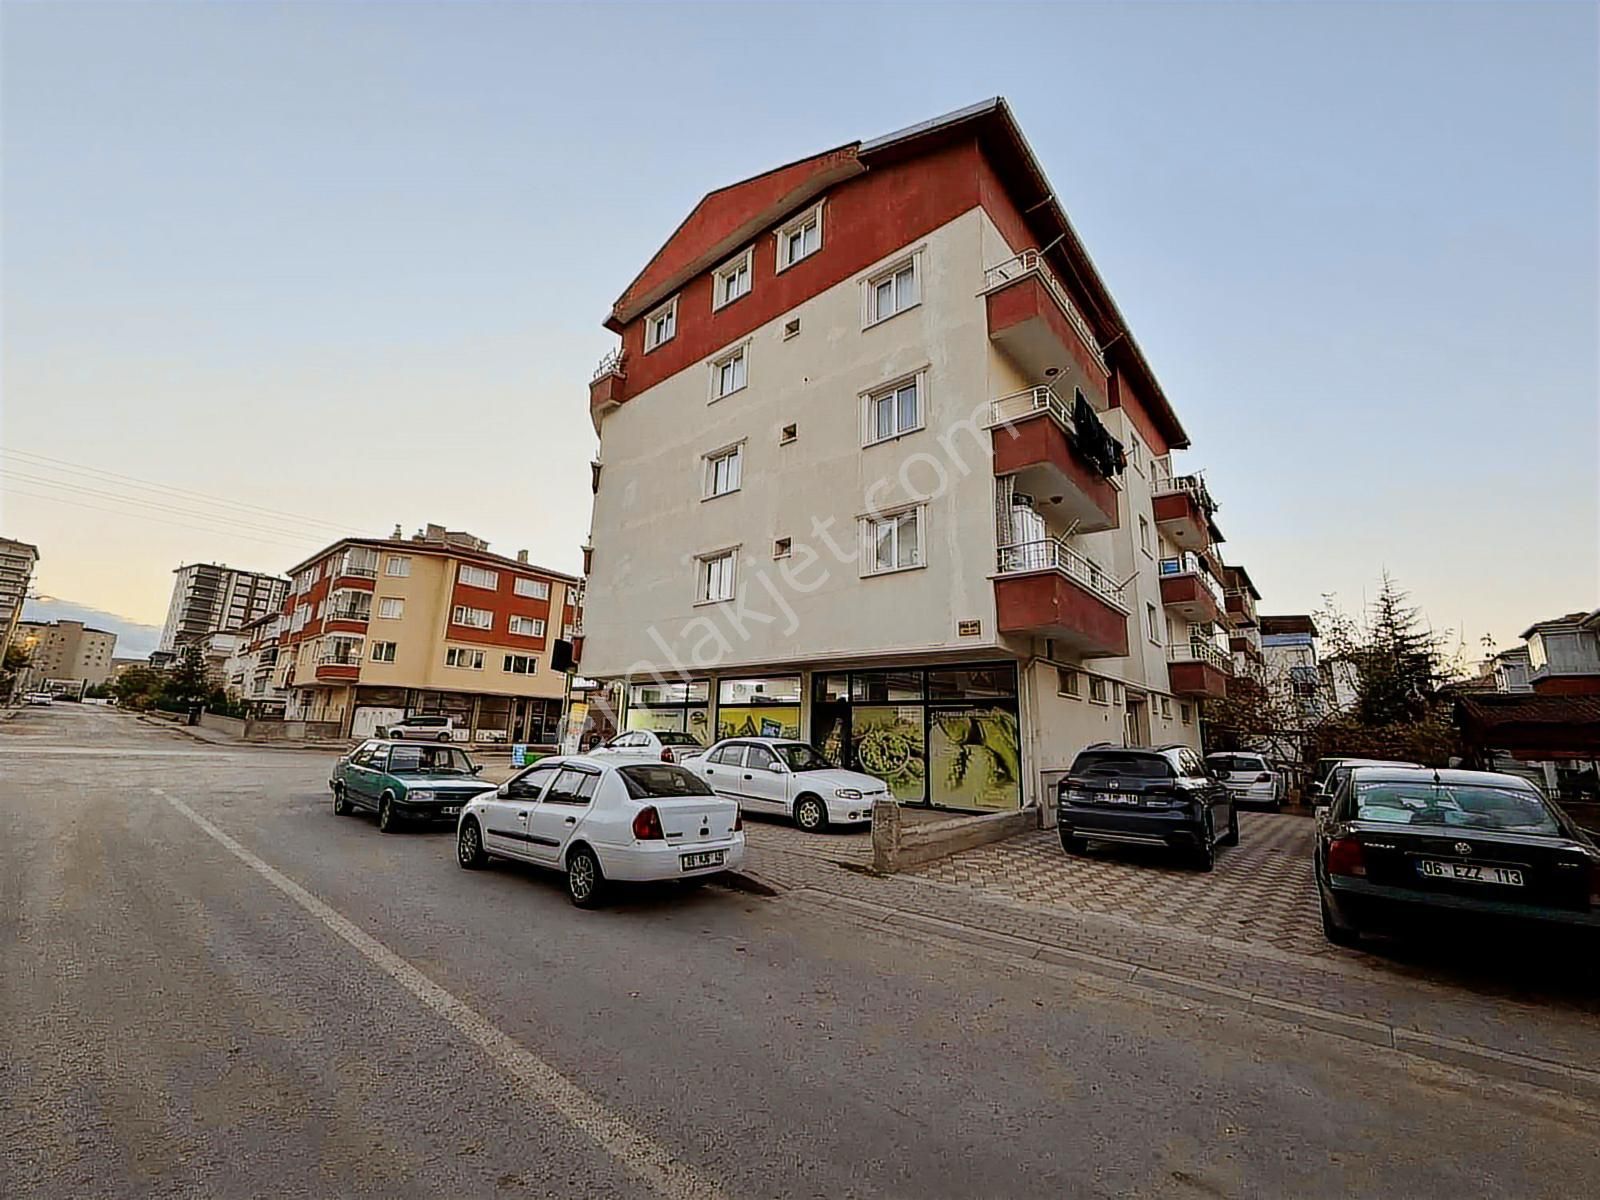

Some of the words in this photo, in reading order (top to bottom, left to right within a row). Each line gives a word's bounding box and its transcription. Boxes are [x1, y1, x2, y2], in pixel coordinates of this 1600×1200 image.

[1423, 861, 1443, 875] 06
[1453, 863, 1484, 881] EZZ
[1495, 868, 1521, 885] 113
